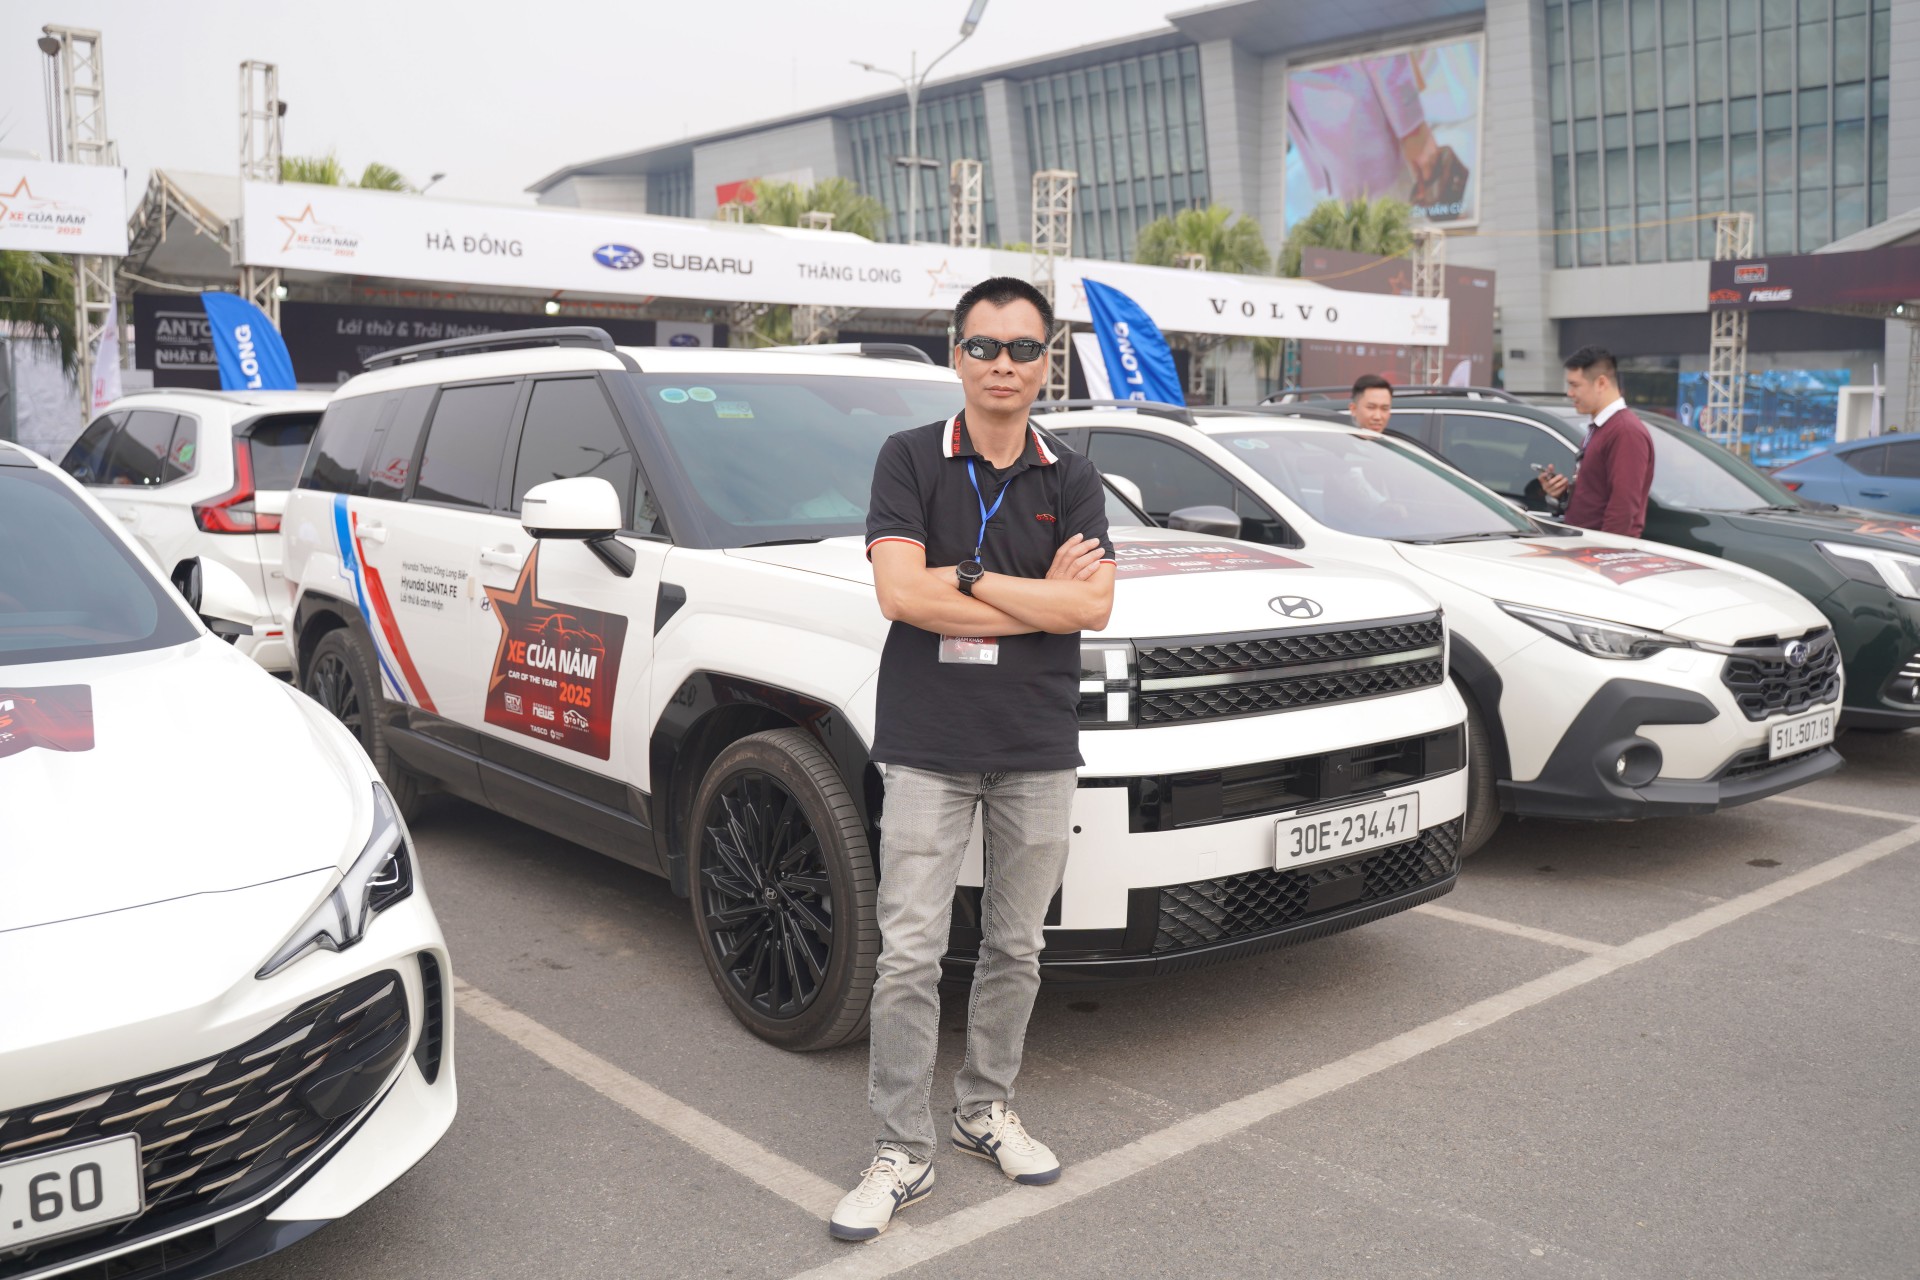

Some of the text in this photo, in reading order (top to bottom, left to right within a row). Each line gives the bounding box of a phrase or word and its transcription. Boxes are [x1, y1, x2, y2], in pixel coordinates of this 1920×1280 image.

[426, 229, 523, 257] HÀ ĐÔNG
[652, 252, 753, 275] SUBARU
[798, 261, 902, 284] THĂNG LONG
[1209, 298, 1339, 323] VOLVO
[157, 318, 187, 336] AN
[234, 324, 263, 390] LONG
[1114, 321, 1144, 385] LONG
[401, 576, 458, 598] Hyundai SANTA FE
[507, 639, 598, 680] XE CỦA NĂM
[507, 670, 558, 688] CAR OF THE YEAR
[559, 681, 592, 708] 2025
[530, 724, 549, 736] TASCO
[1776, 716, 1830, 750] 51L-507.19
[1290, 803, 1408, 857] 30E-234.47
